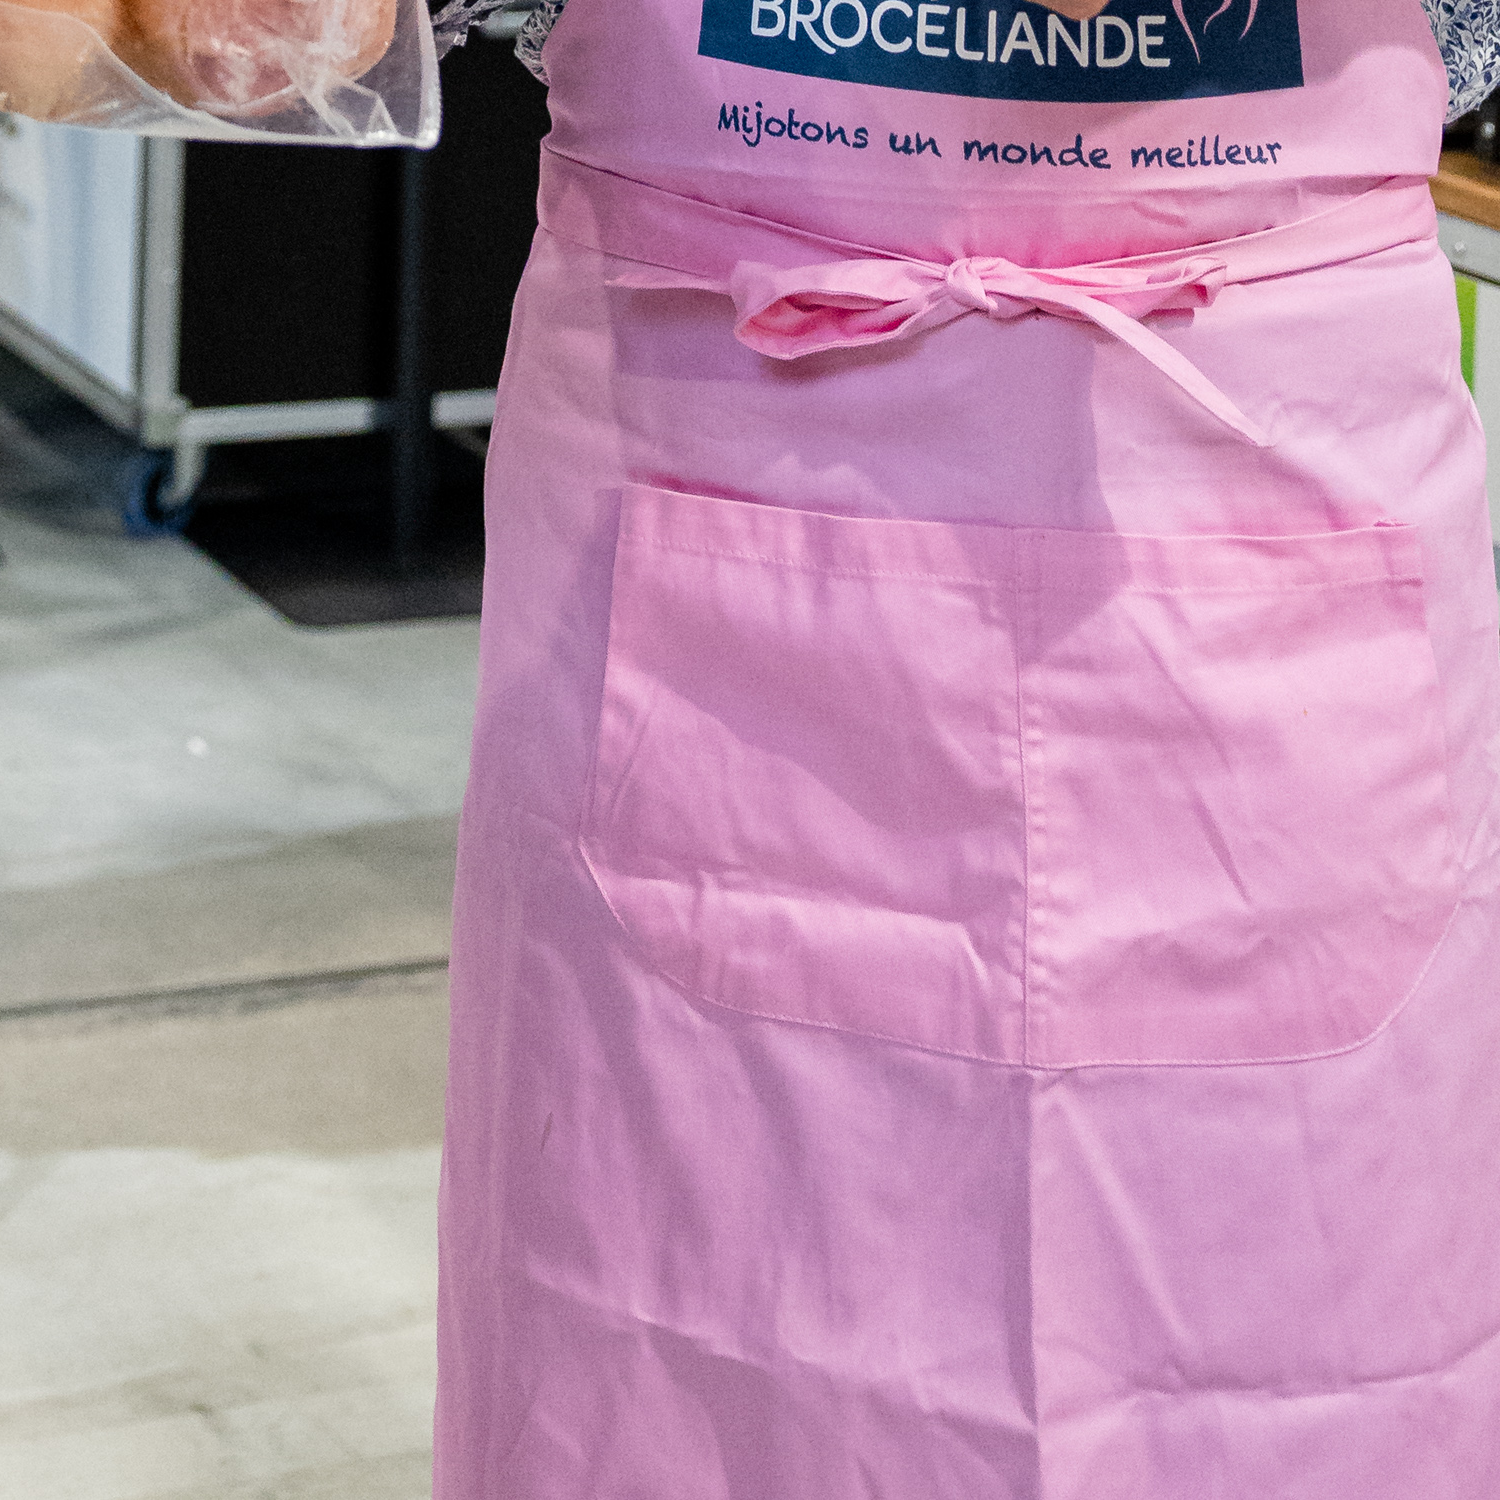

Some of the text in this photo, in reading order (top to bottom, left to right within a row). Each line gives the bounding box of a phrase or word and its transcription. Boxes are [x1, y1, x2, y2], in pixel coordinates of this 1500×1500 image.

[718, 101, 1282, 169] Mijotons un monde meilleur
